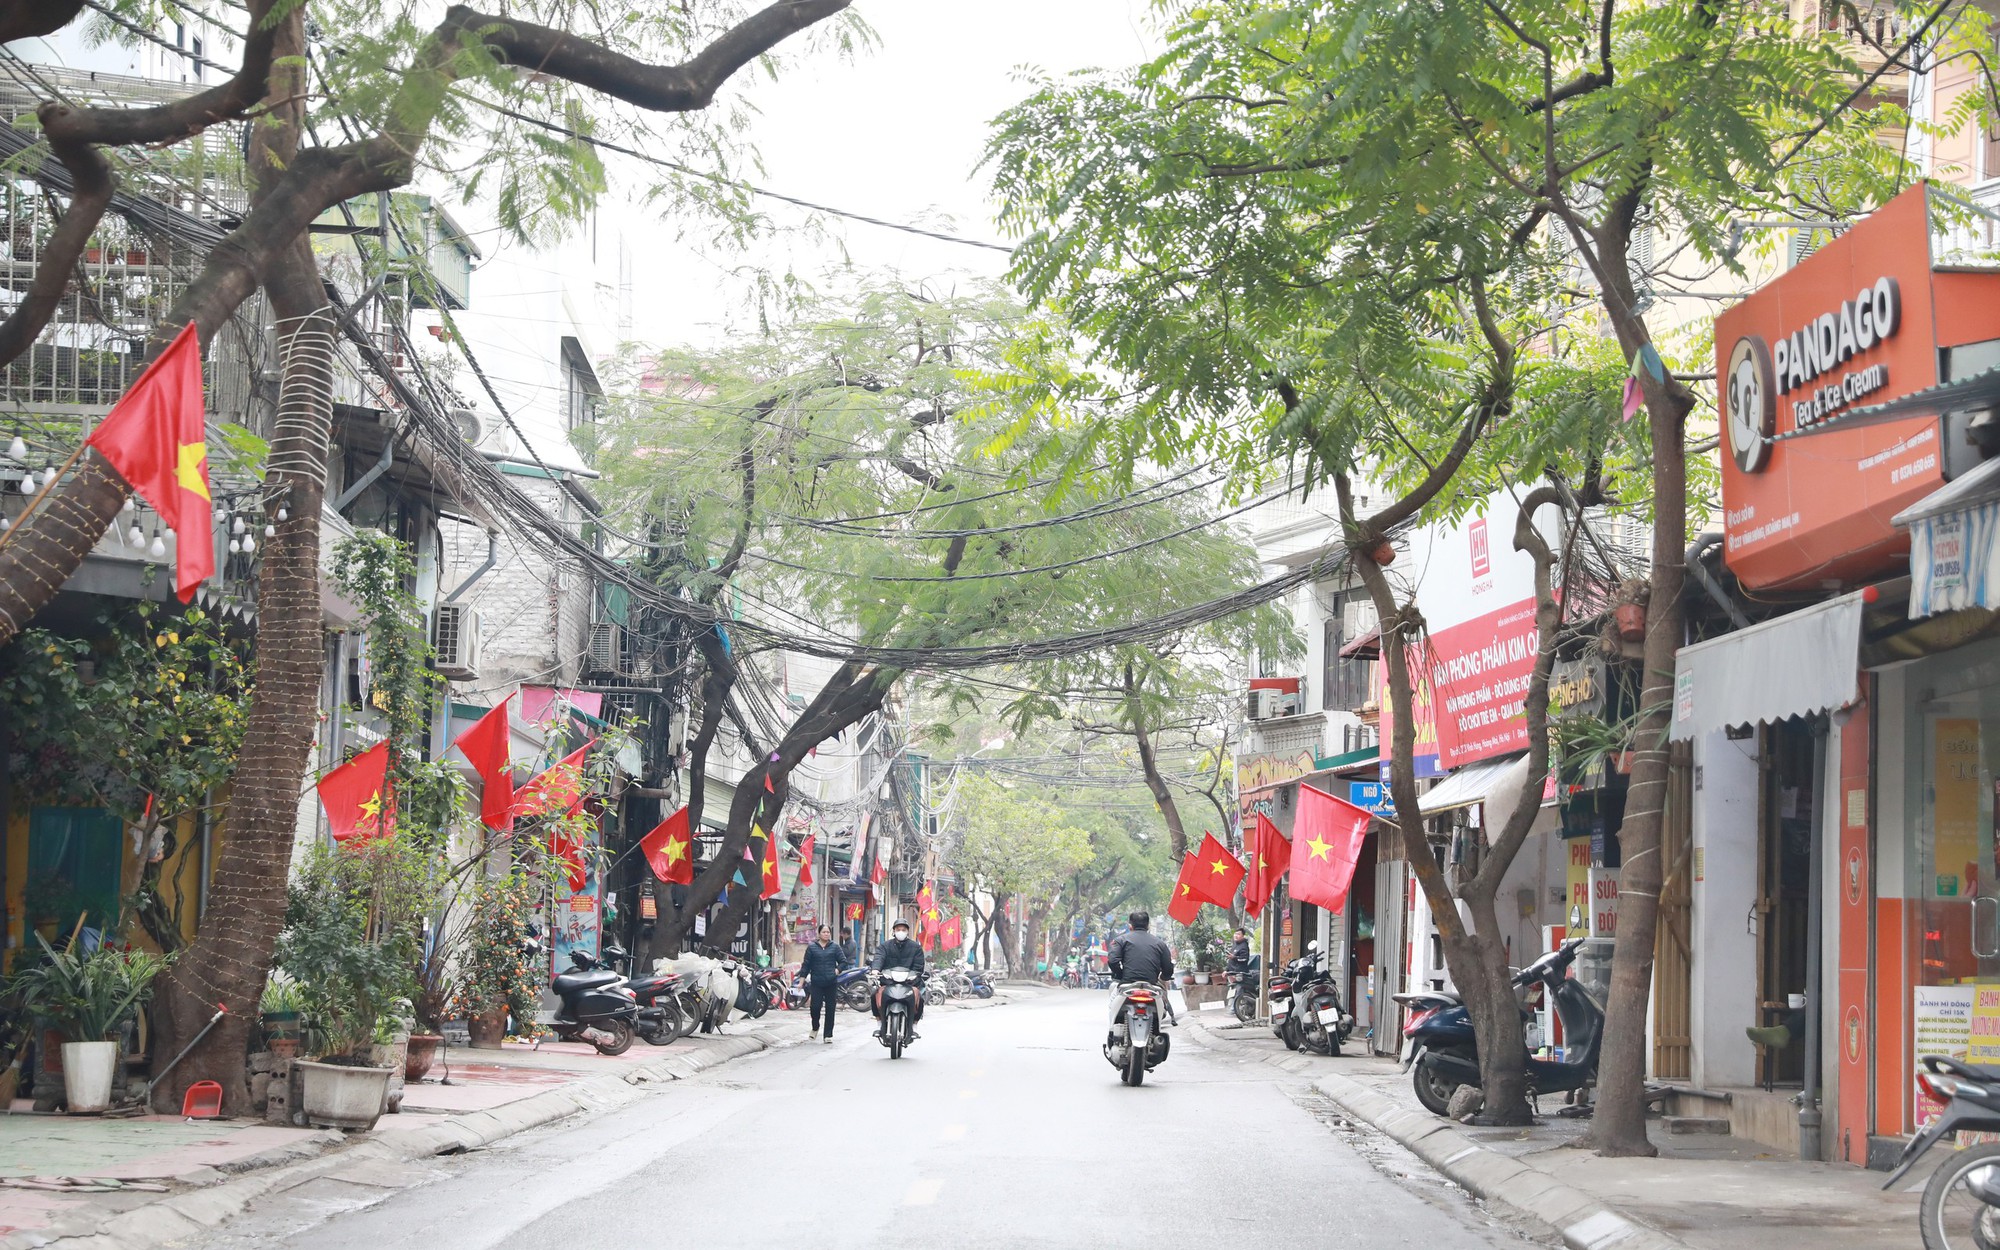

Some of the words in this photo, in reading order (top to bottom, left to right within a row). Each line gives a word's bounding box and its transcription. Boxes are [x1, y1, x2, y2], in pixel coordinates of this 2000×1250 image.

[1774, 276, 1894, 395] PANDAGO
[1793, 401, 1810, 428] Tea
[1814, 389, 1822, 418] &
[1825, 384, 1840, 413] Ice
[1842, 364, 1881, 402] Cream
[1449, 649, 1480, 682] PHÒNG
[1482, 634, 1508, 671] PHẨM
[1508, 634, 1527, 662] KIM
[1476, 682, 1492, 704] PHẨM
[1504, 677, 1520, 696] DÙNG
[1596, 873, 1617, 900] SỬA
[731, 939, 748, 953] NỮ
